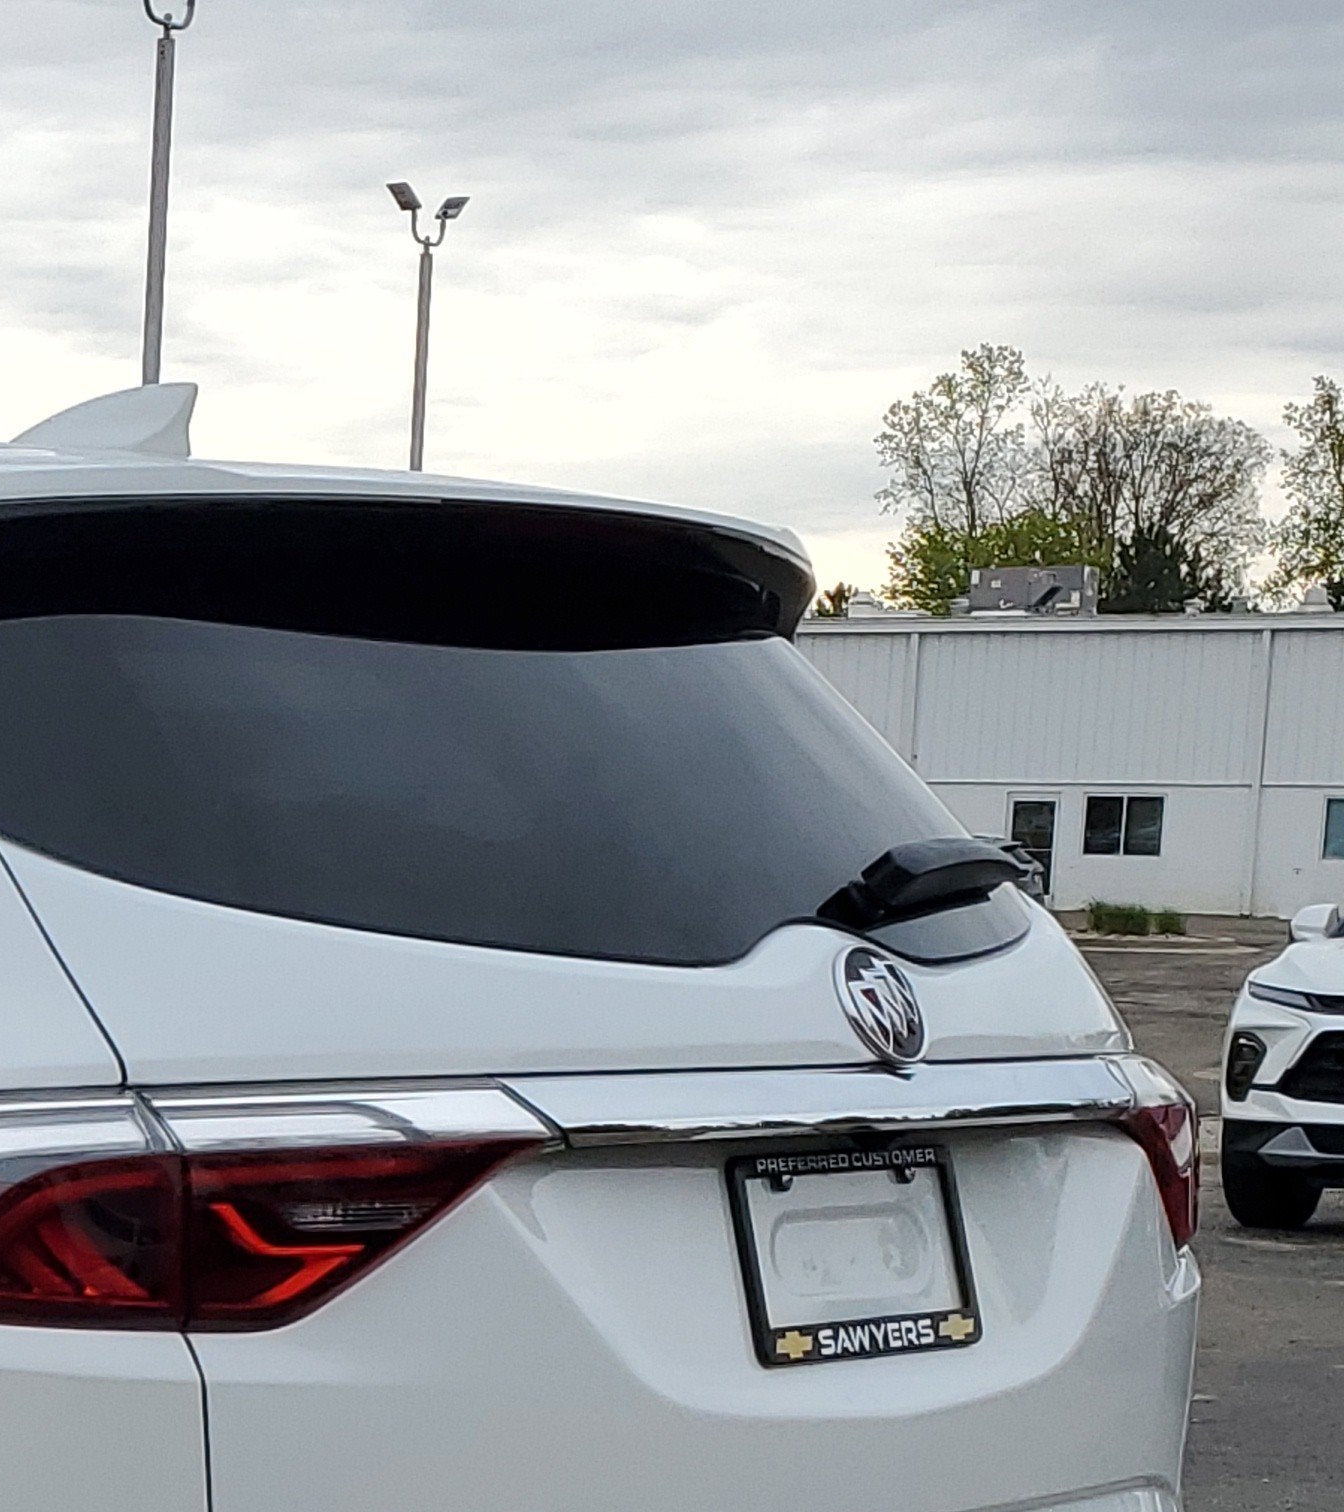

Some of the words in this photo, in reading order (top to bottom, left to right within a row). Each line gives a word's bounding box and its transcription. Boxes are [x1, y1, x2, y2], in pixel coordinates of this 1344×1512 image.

[756, 1154, 849, 1173] PREFERRED
[852, 1148, 935, 1167] CUSTOMER
[818, 1319, 934, 1356] SAWYERS
